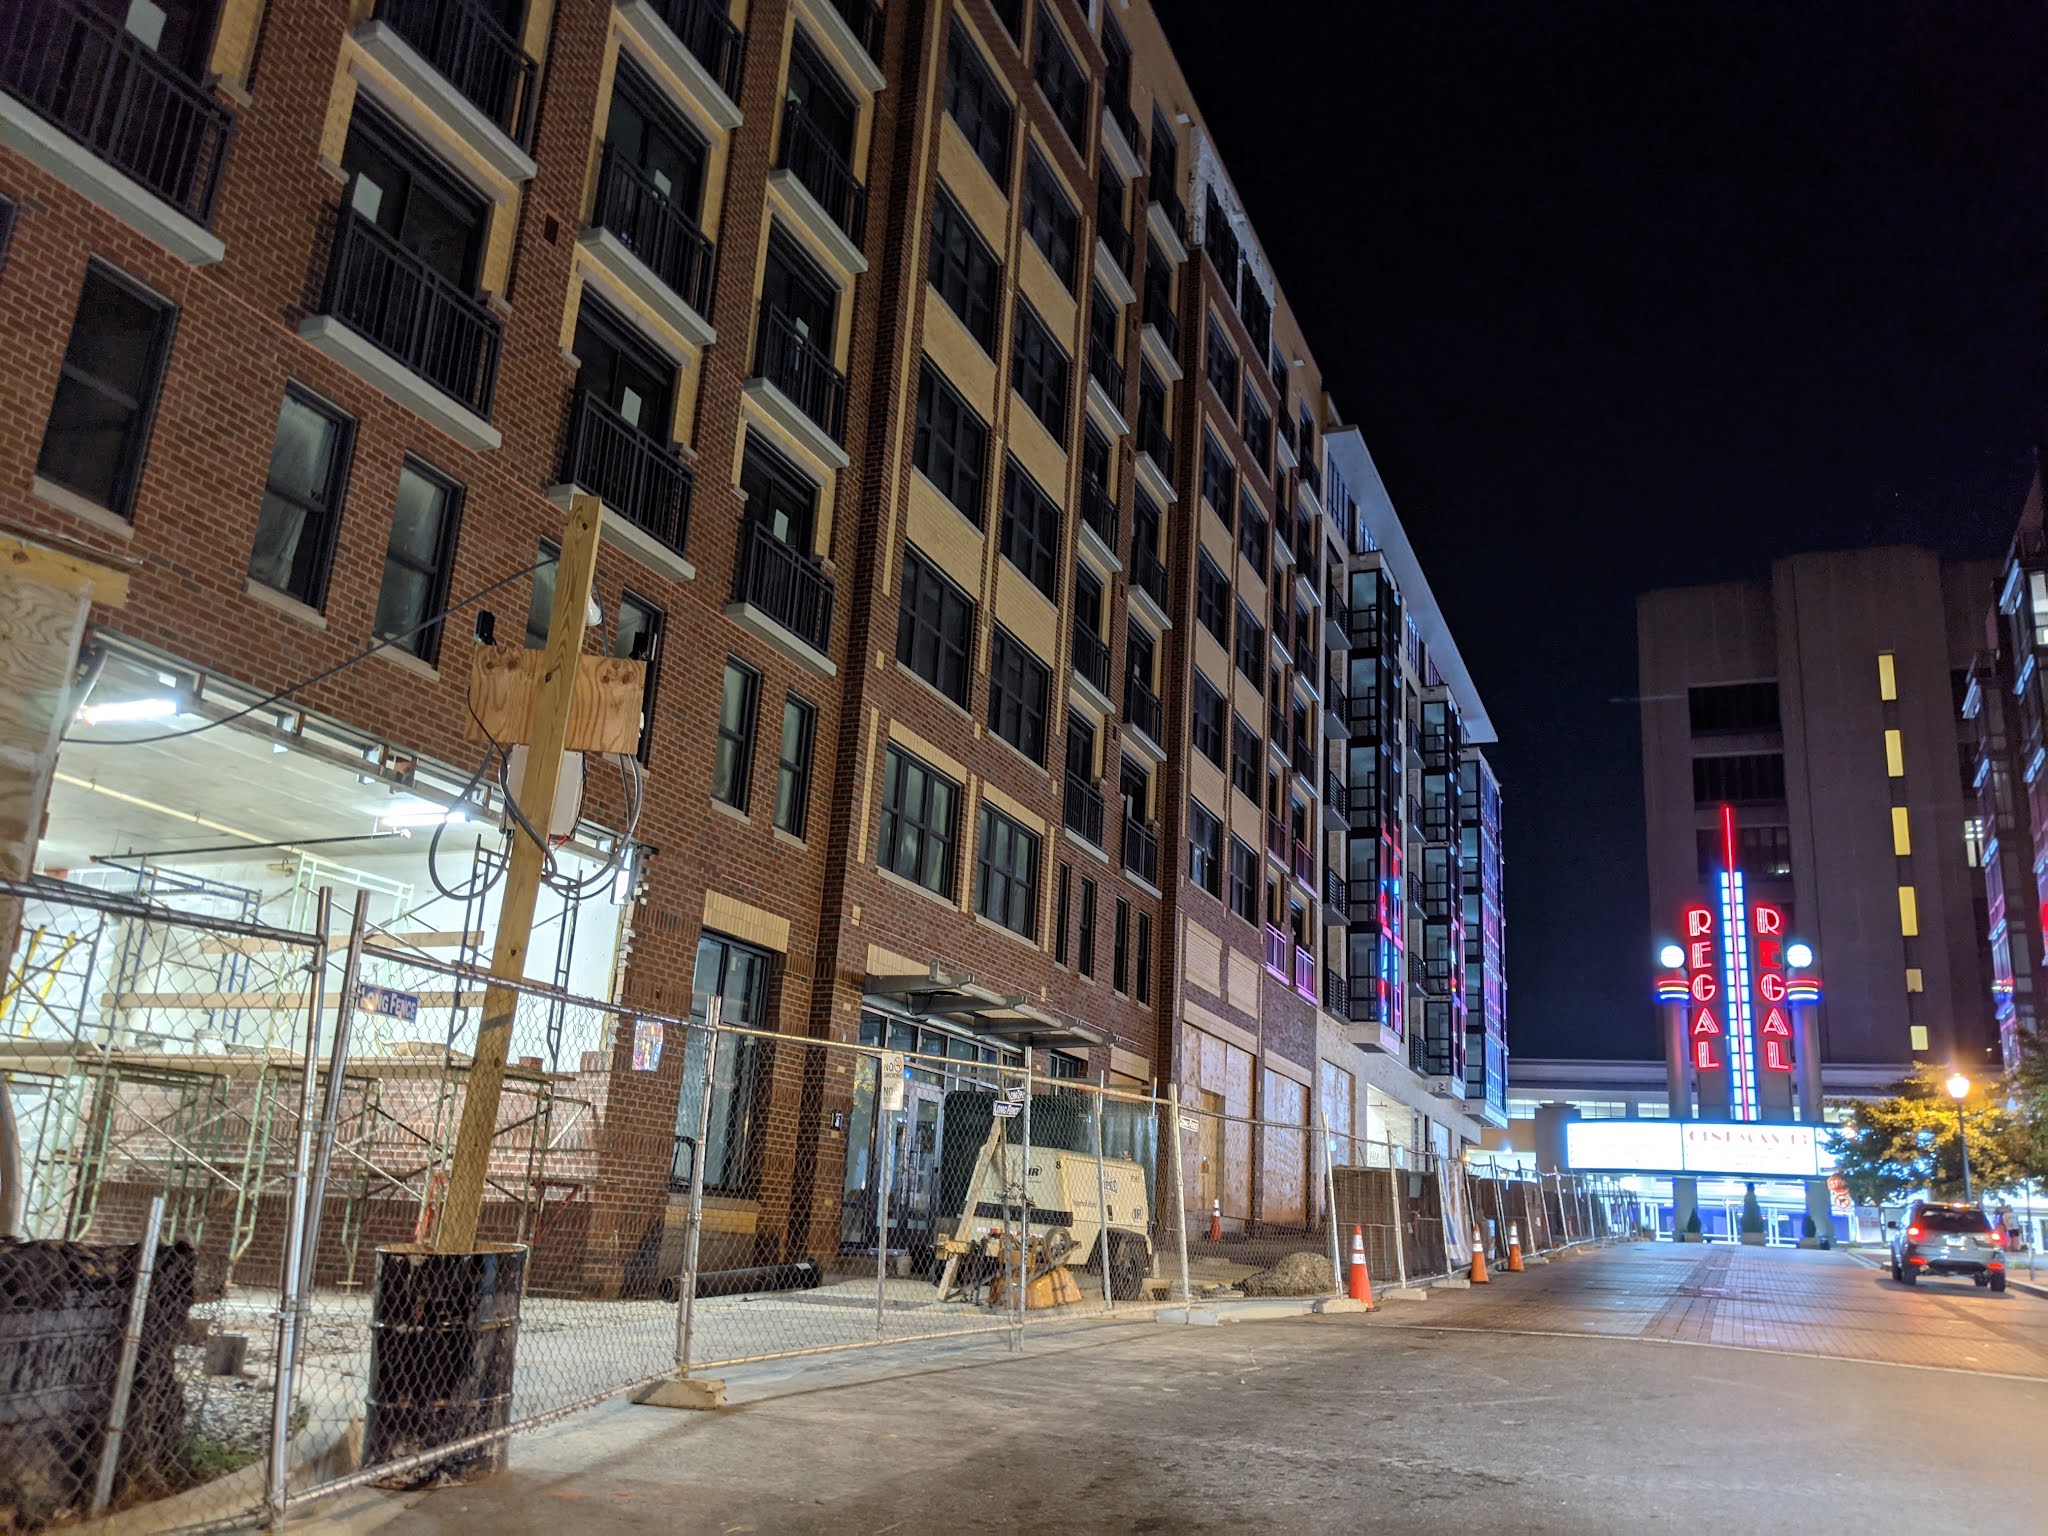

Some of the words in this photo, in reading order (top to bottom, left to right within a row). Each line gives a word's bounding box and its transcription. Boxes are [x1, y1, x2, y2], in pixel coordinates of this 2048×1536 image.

[1688, 909, 1720, 1069] REGAL
[1756, 907, 1790, 1070] REGAL
[390, 993, 416, 1019] FENCE
[884, 1062, 894, 1071] NO
[884, 1086, 894, 1096] NO
[1056, 1161, 1062, 1170] 8
[1028, 1167, 1040, 1177] IR
